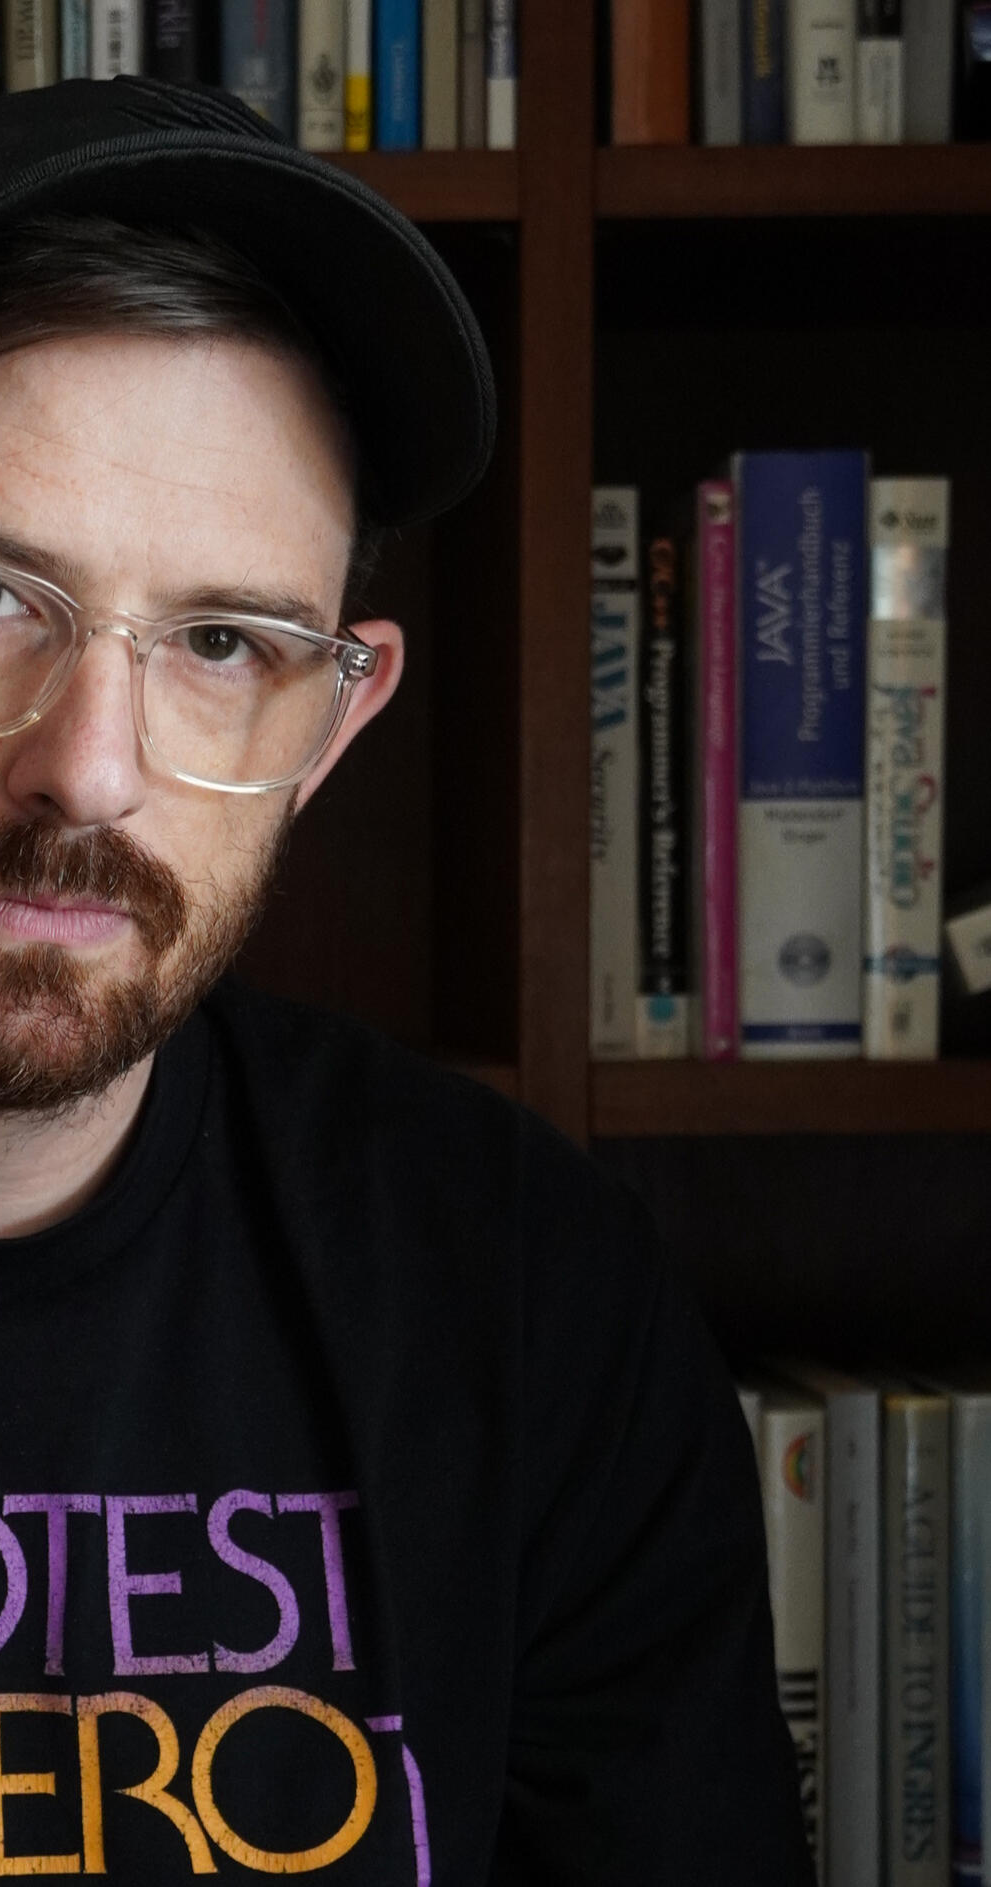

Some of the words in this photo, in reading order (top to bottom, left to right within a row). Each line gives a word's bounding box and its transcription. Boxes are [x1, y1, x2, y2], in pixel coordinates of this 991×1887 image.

[755, 564, 793, 666] JAVA
[797, 490, 825, 743] Programmierhandbuch
[827, 540, 852, 640] Referenz
[591, 603, 627, 732] JAVA
[827, 647, 852, 690] und
[650, 830, 675, 959] Reference
